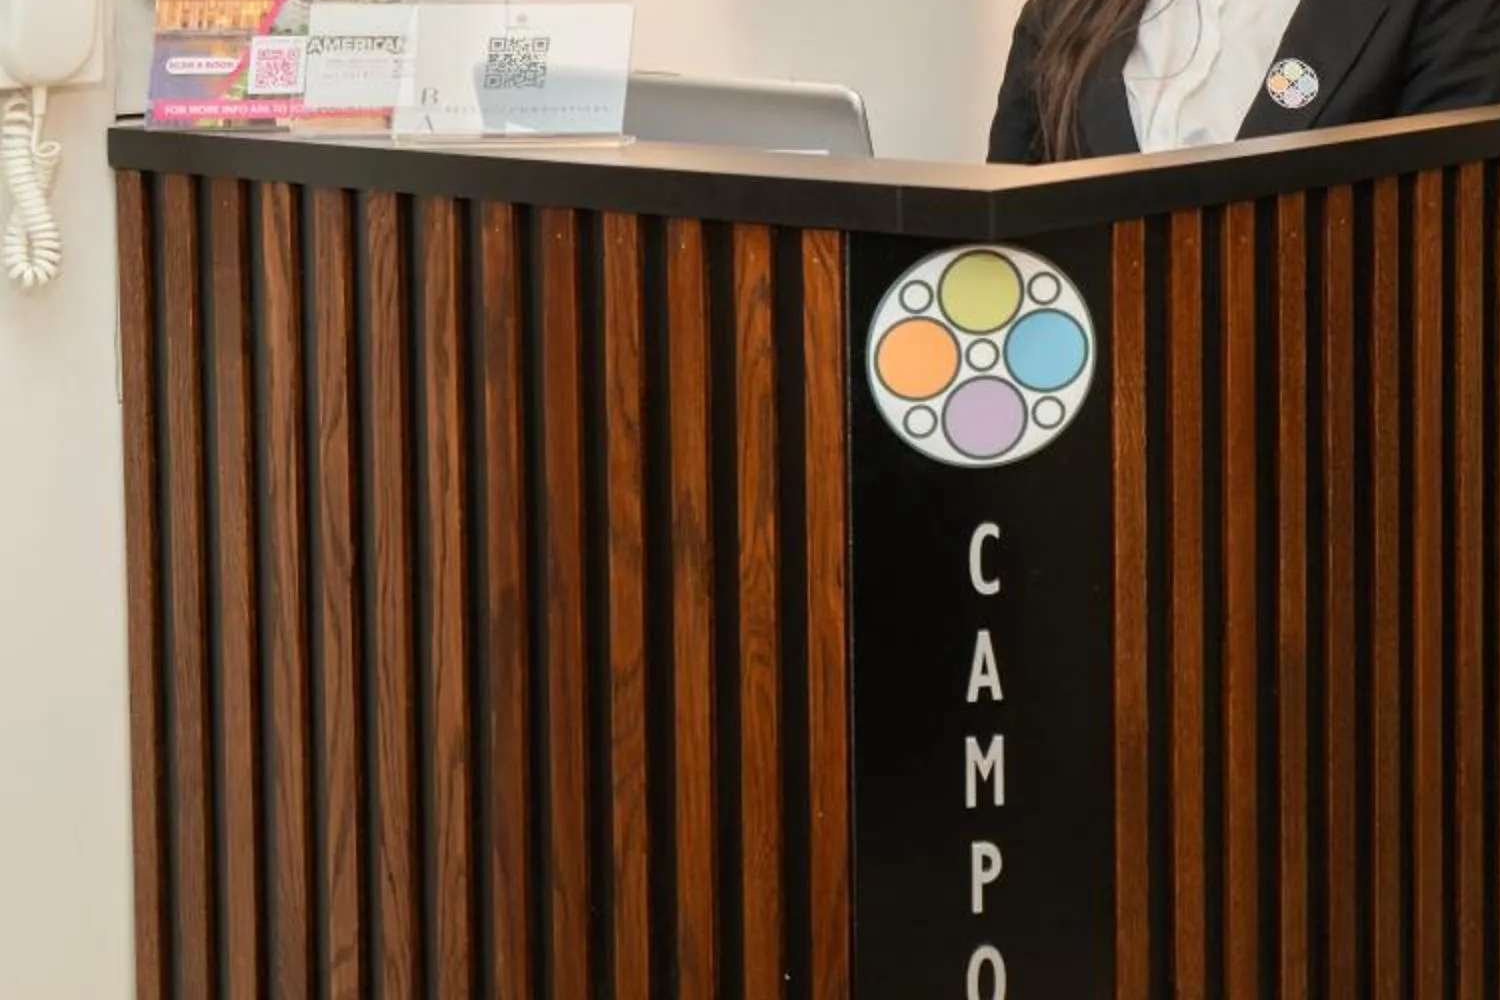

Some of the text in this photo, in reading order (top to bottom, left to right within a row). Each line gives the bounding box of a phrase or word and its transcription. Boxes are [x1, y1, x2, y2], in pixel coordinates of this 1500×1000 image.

[164, 103, 187, 116] FOR
[189, 103, 219, 116] MORE
[221, 103, 248, 116] INFO
[965, 521, 1006, 1000] CAMPO
